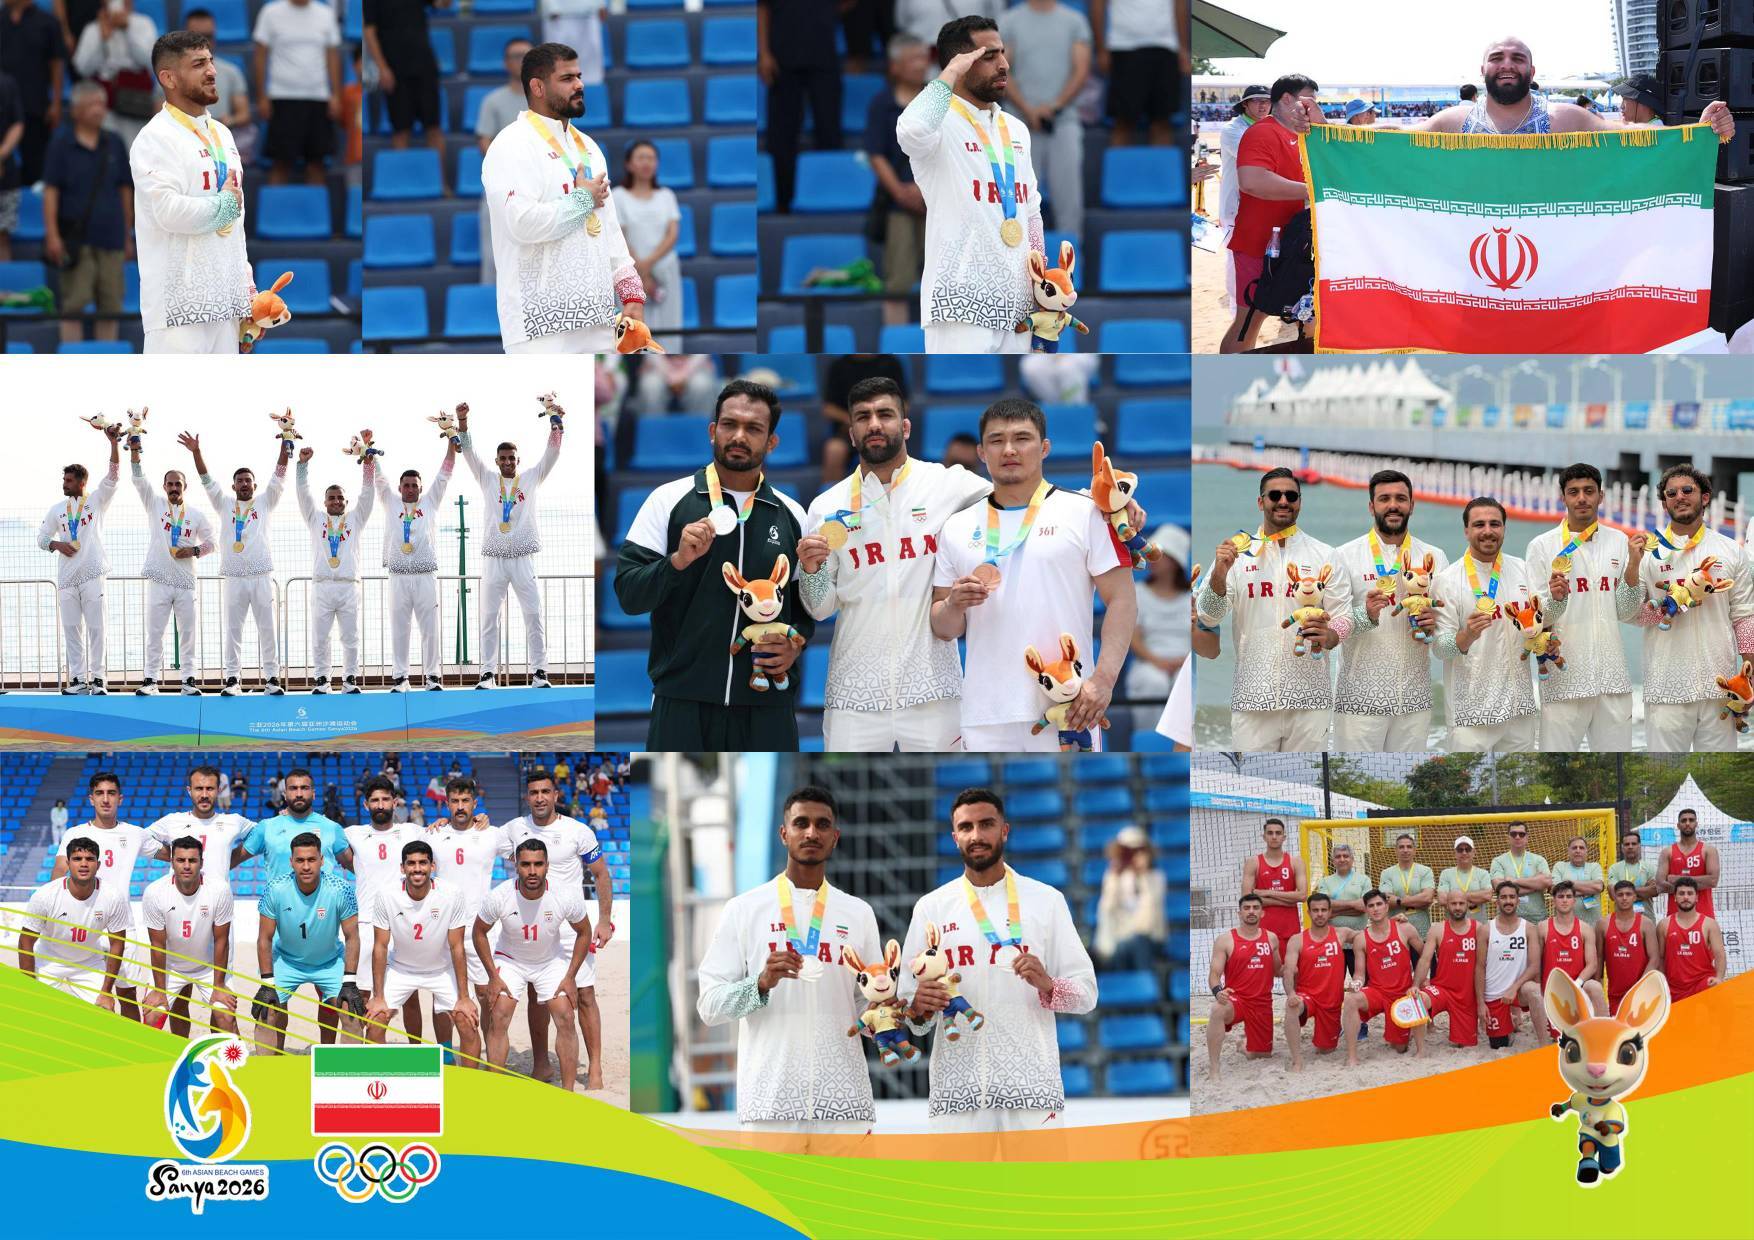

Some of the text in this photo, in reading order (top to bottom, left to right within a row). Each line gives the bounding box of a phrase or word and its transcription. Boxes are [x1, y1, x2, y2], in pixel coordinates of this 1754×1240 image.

[1247, 581, 1296, 598] IRA
[1568, 576, 1620, 593] RA
[104, 849, 113, 868] 3
[379, 843, 387, 860] 8
[455, 848, 464, 865] 6
[1687, 855, 1701, 868] 85
[1281, 867, 1289, 880] 9
[70, 926, 88, 943] 10
[182, 920, 192, 938] 5
[299, 922, 307, 939] 1
[413, 923, 423, 940] 2
[521, 924, 538, 941] 11
[943, 922, 960, 934] I.R.
[1462, 937, 1476, 951] 88
[1509, 936, 1525, 950] 22
[1570, 936, 1579, 950] 8
[1629, 932, 1638, 947] 4
[1687, 930, 1701, 945] 10
[1255, 942, 1270, 956] 58
[1325, 941, 1339, 956] 21
[1386, 940, 1401, 956] 13
